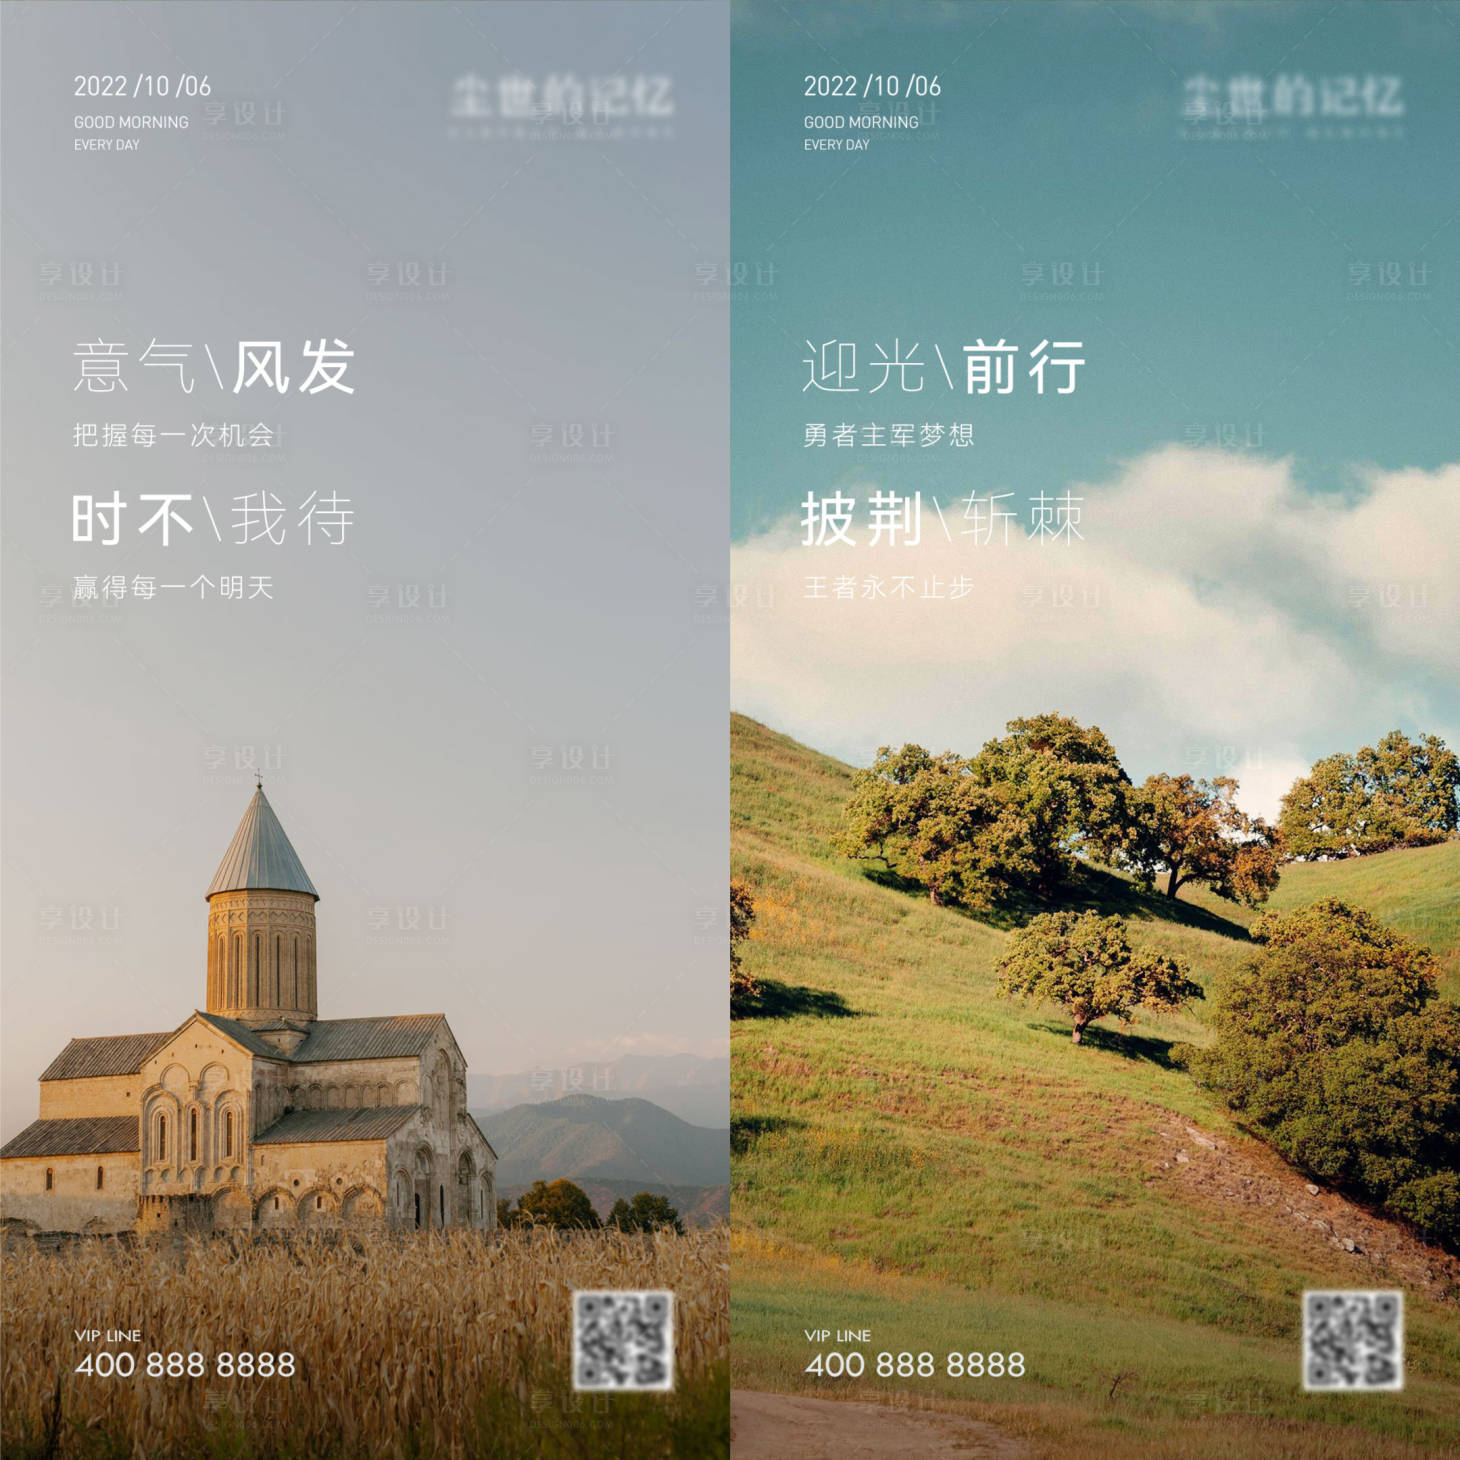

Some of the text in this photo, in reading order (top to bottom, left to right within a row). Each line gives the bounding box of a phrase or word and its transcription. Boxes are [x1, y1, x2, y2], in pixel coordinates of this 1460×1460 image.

[74, 73, 211, 98] 2022 /10 /06
[804, 73, 941, 98] 2022 /10 /06
[74, 115, 189, 129] GOOD MORNING
[804, 115, 919, 129] GOOD MORNING
[74, 138, 140, 151] EVERY DAY
[804, 138, 870, 151] EVERY DAY
[73, 422, 273, 448] 把握每一次机会
[804, 422, 974, 448] 勇者主军梦想
[73, 574, 273, 600] 赢得每一个明天
[804, 575, 972, 600] 王者永不止步
[74, 1329, 141, 1342] VIP LINE
[804, 1329, 871, 1342] VIP LINE
[74, 1351, 296, 1378] 400 888 8888
[805, 1351, 1025, 1378] 400 888 8888
